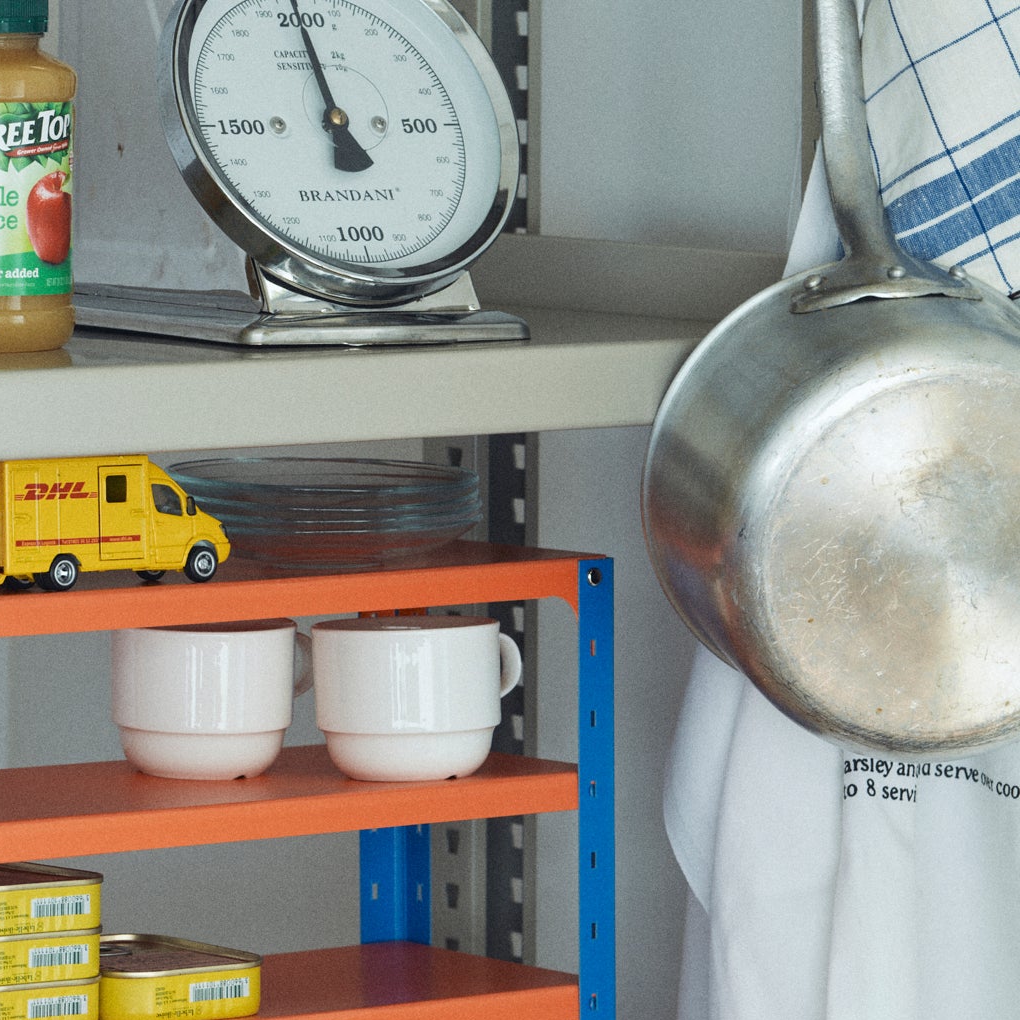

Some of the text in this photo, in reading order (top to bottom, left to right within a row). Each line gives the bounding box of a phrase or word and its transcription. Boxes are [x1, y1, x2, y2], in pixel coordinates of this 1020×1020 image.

[277, 12, 325, 28] 2000
[231, 29, 250, 38] 1800
[217, 53, 235, 62] 1700
[273, 50, 309, 59] CAPACIT
[210, 86, 229, 95] 1600
[37, 109, 71, 143] TOP
[218, 119, 265, 135] 1500
[401, 118, 438, 134] 500
[229, 158, 248, 167] 1400
[253, 190, 272, 199] 1300
[299, 188, 395, 202] BRANDANI
[282, 216, 301, 225] 1200
[336, 225, 384, 242] 1000
[5, 267, 39, 279] added
[23, 481, 90, 501] DHL
[844, 757, 894, 778] arsley
[934, 762, 979, 783] serve
[996, 781, 1020, 800] coo
[866, 778, 877, 797] 8
